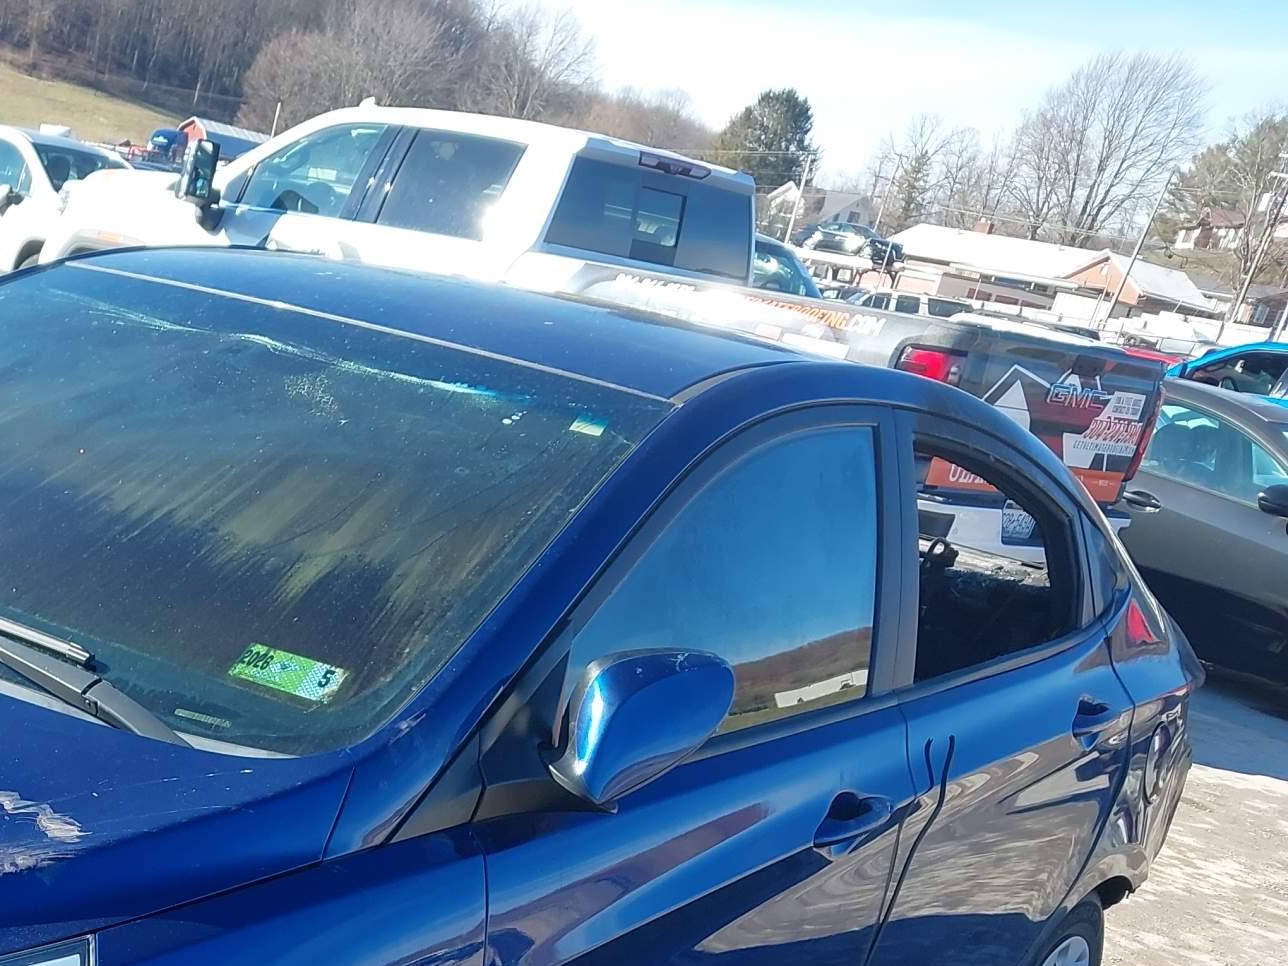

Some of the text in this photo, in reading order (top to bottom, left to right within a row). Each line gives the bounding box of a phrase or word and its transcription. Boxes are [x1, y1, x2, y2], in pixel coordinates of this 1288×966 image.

[1047, 383, 1108, 410] GMC
[241, 649, 274, 670] 2026
[317, 669, 336, 688] 5
